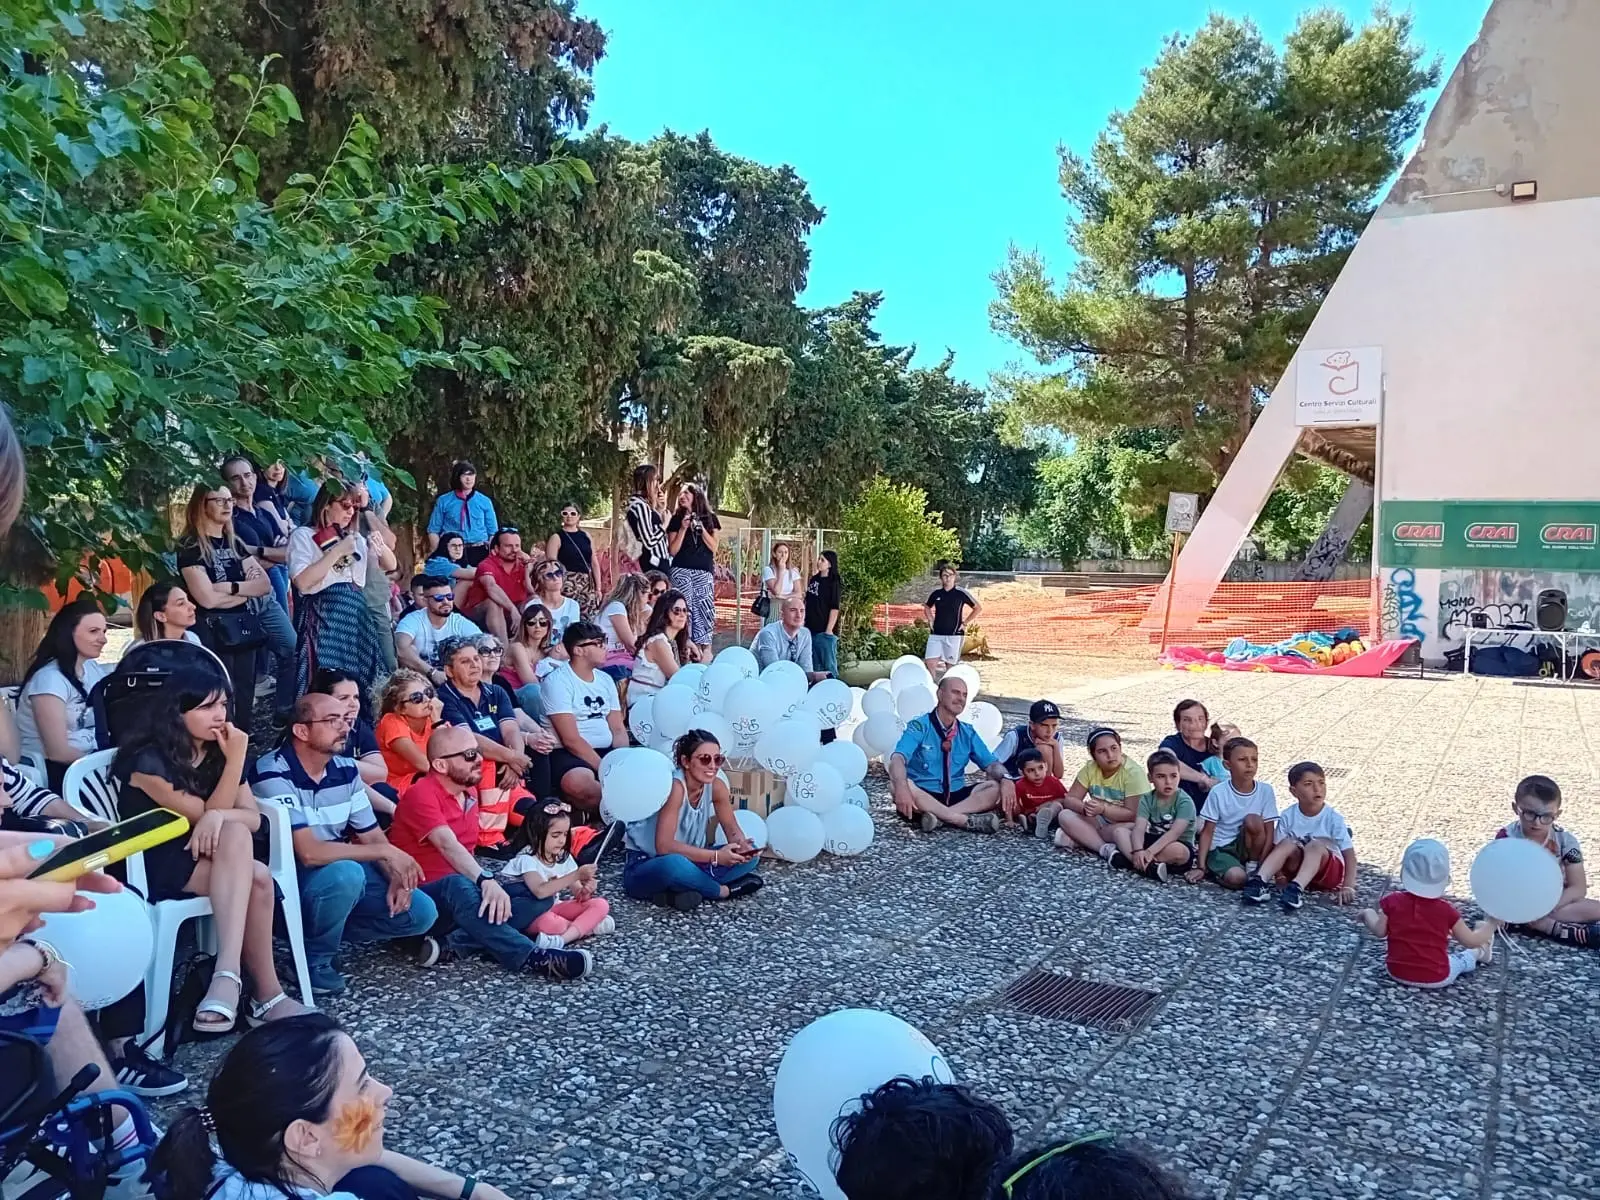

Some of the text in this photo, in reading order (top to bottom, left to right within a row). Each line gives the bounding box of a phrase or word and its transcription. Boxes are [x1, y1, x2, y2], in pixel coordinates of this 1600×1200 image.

[1299, 397, 1377, 408] Centro Servizi Culturali
[1396, 525, 1441, 539] CRAI
[1468, 525, 1516, 540] CRAI
[1544, 526, 1593, 541] CRAI
